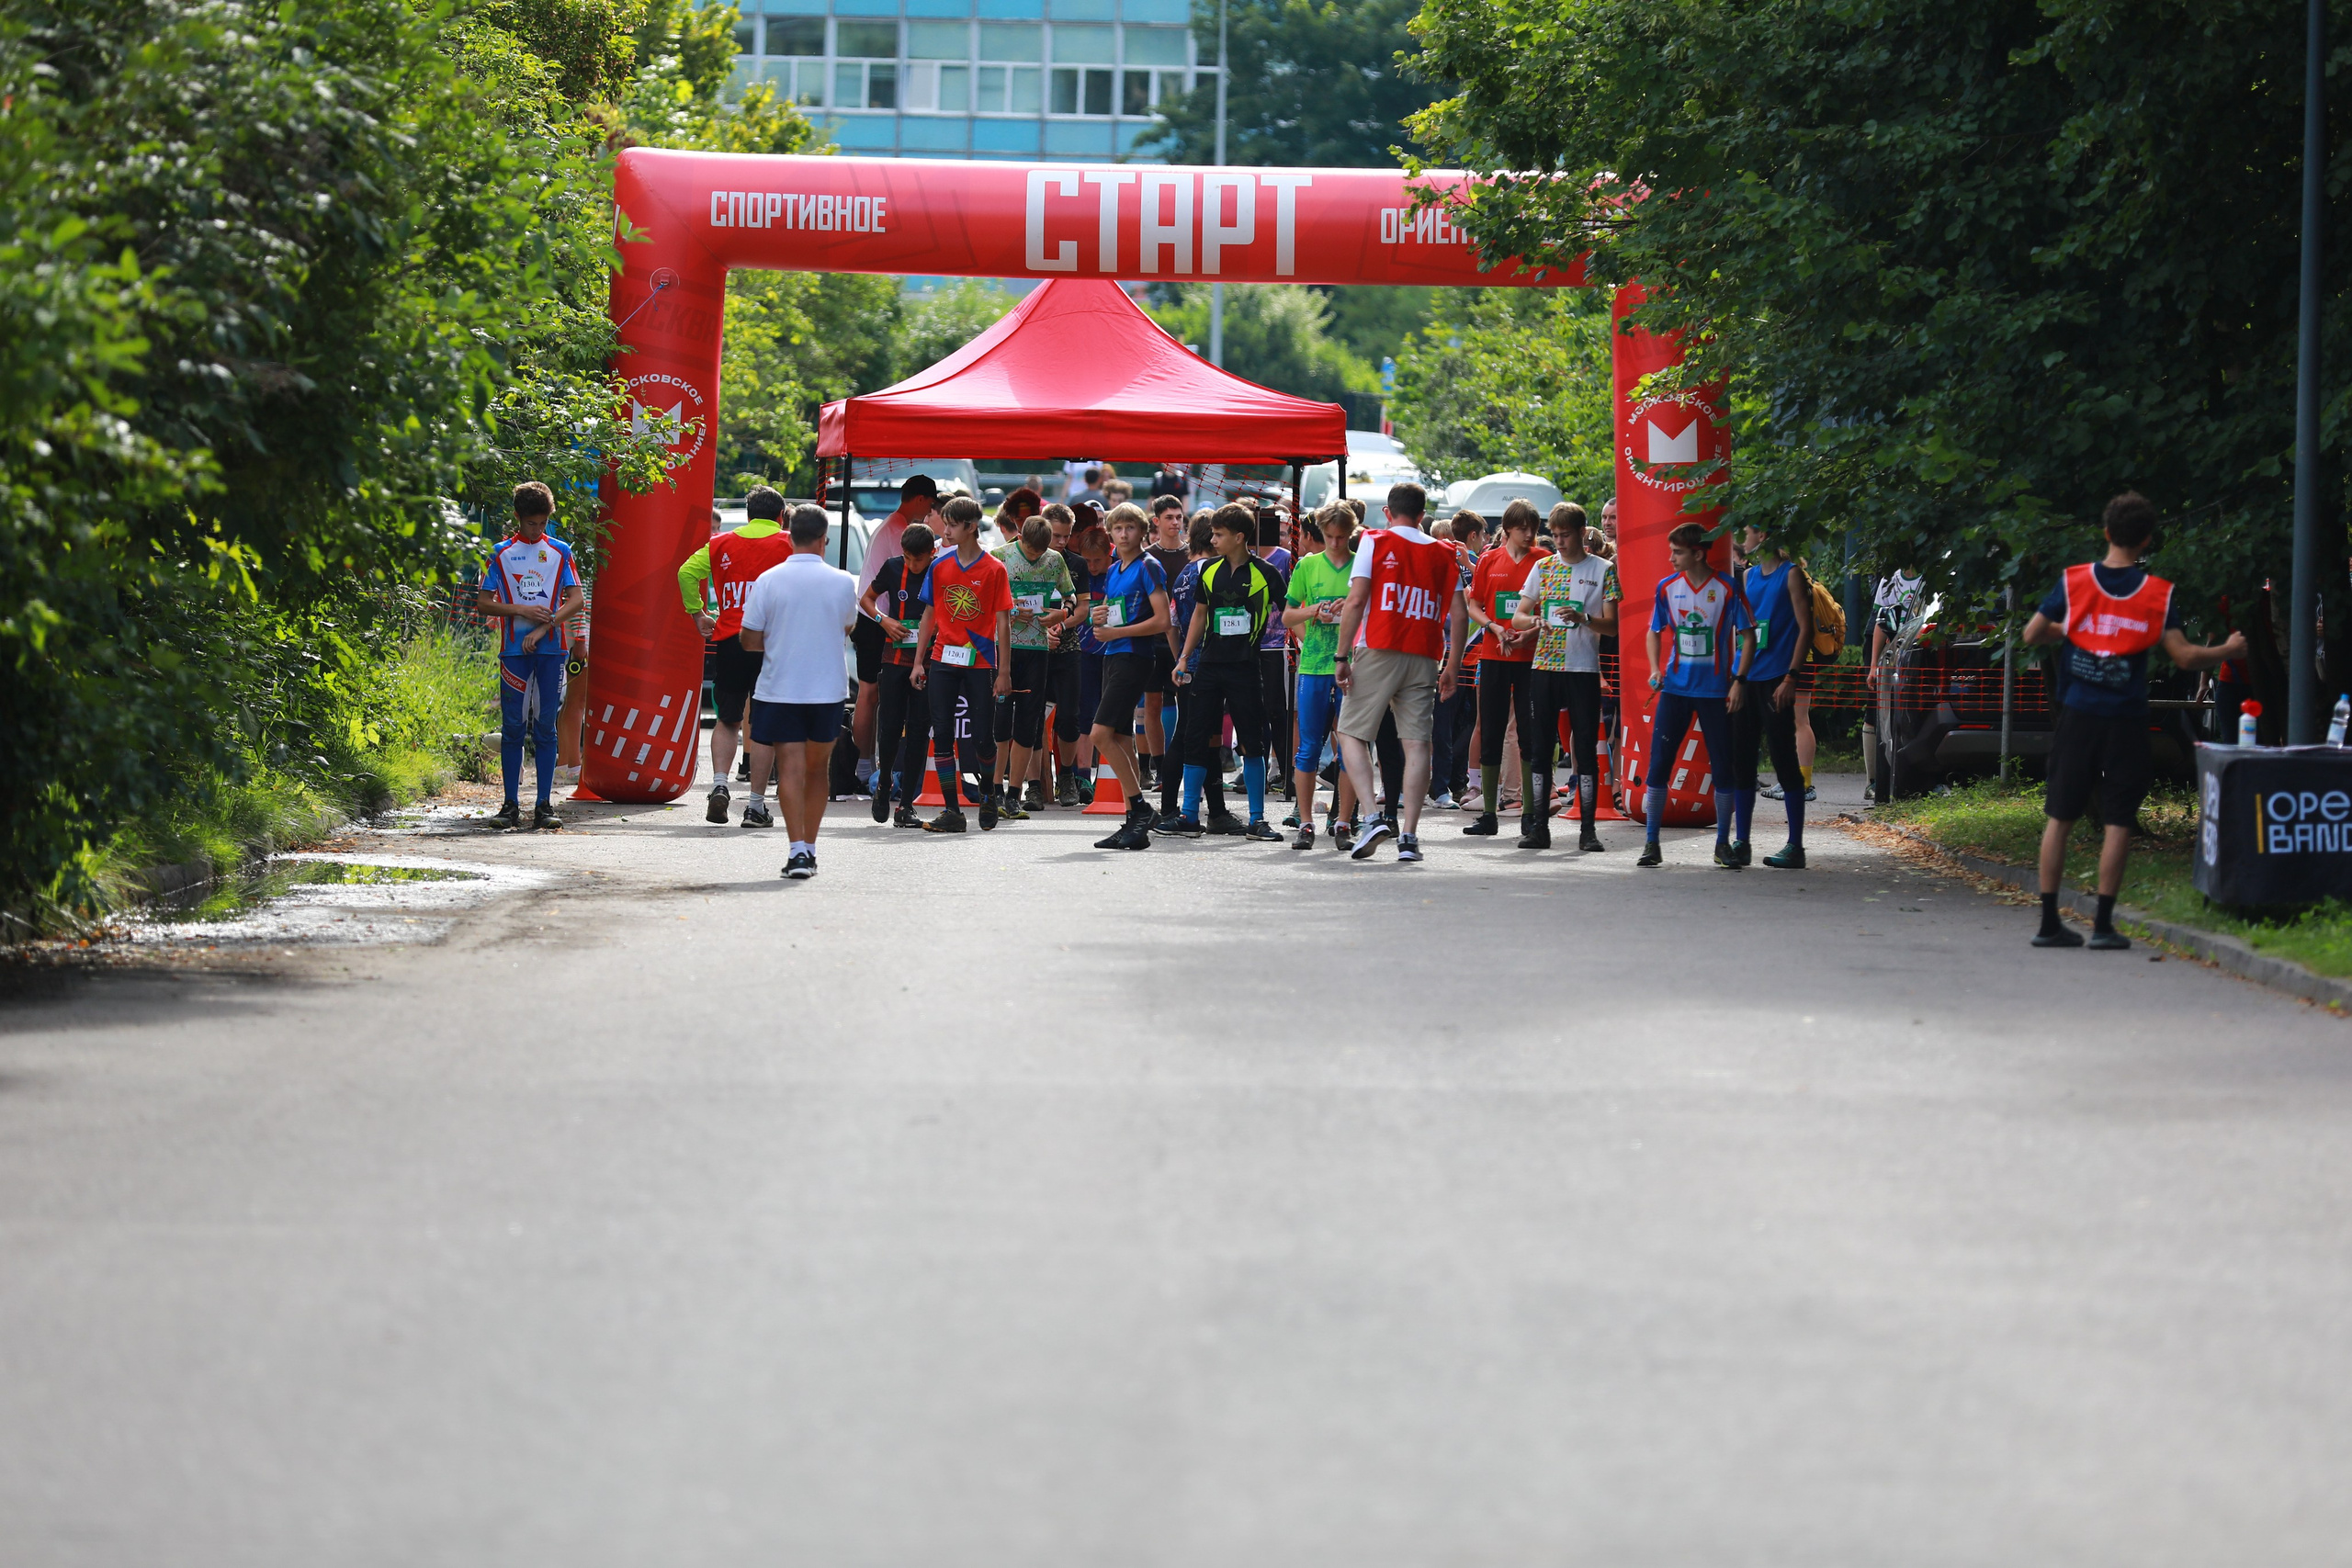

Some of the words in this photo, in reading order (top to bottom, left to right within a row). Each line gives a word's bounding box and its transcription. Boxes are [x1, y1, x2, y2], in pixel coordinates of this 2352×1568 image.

[711, 190, 887, 232] СПОРТИВНОЕ
[1025, 170, 1312, 276] СТАРТ
[620, 374, 704, 406] ОСКОВСКОЕ
[1380, 582, 1442, 624] СУДЬЯ
[1507, 602, 1518, 610] 143
[947, 649, 965, 659] 120.1
[2267, 791, 2351, 822] OPe
